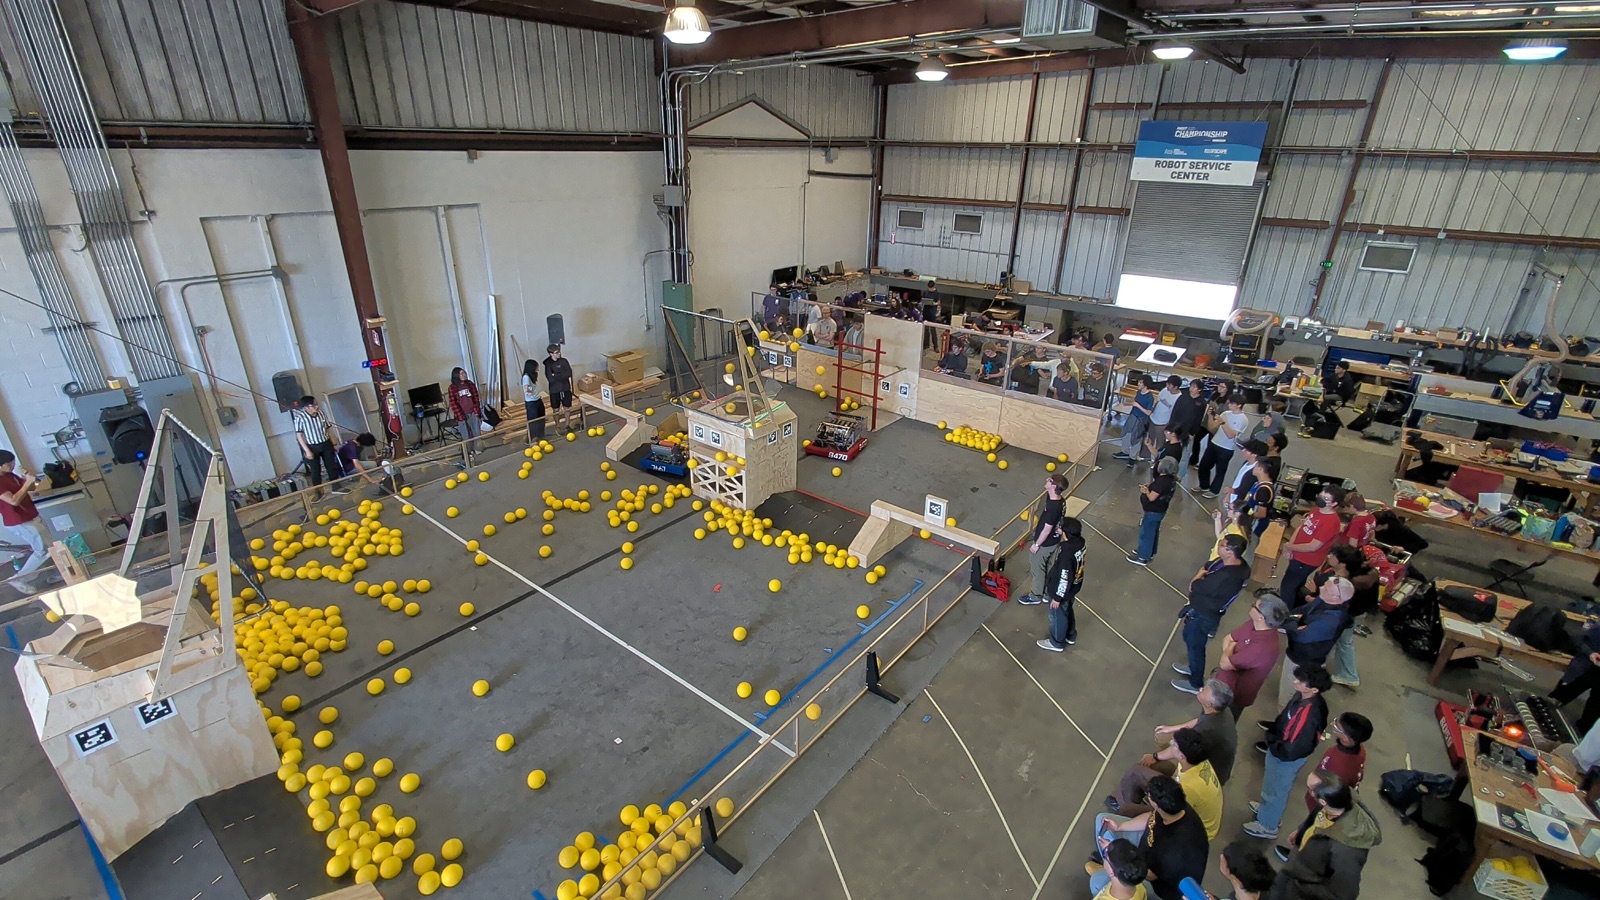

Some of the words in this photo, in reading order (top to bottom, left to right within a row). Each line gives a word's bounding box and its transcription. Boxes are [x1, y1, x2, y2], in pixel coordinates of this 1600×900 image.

[1174, 130, 1228, 138] CHAMPIONSHIP
[1155, 160, 1187, 169] ROBOT
[1189, 161, 1232, 171] SERVICE
[1170, 171, 1209, 180] CENTER
